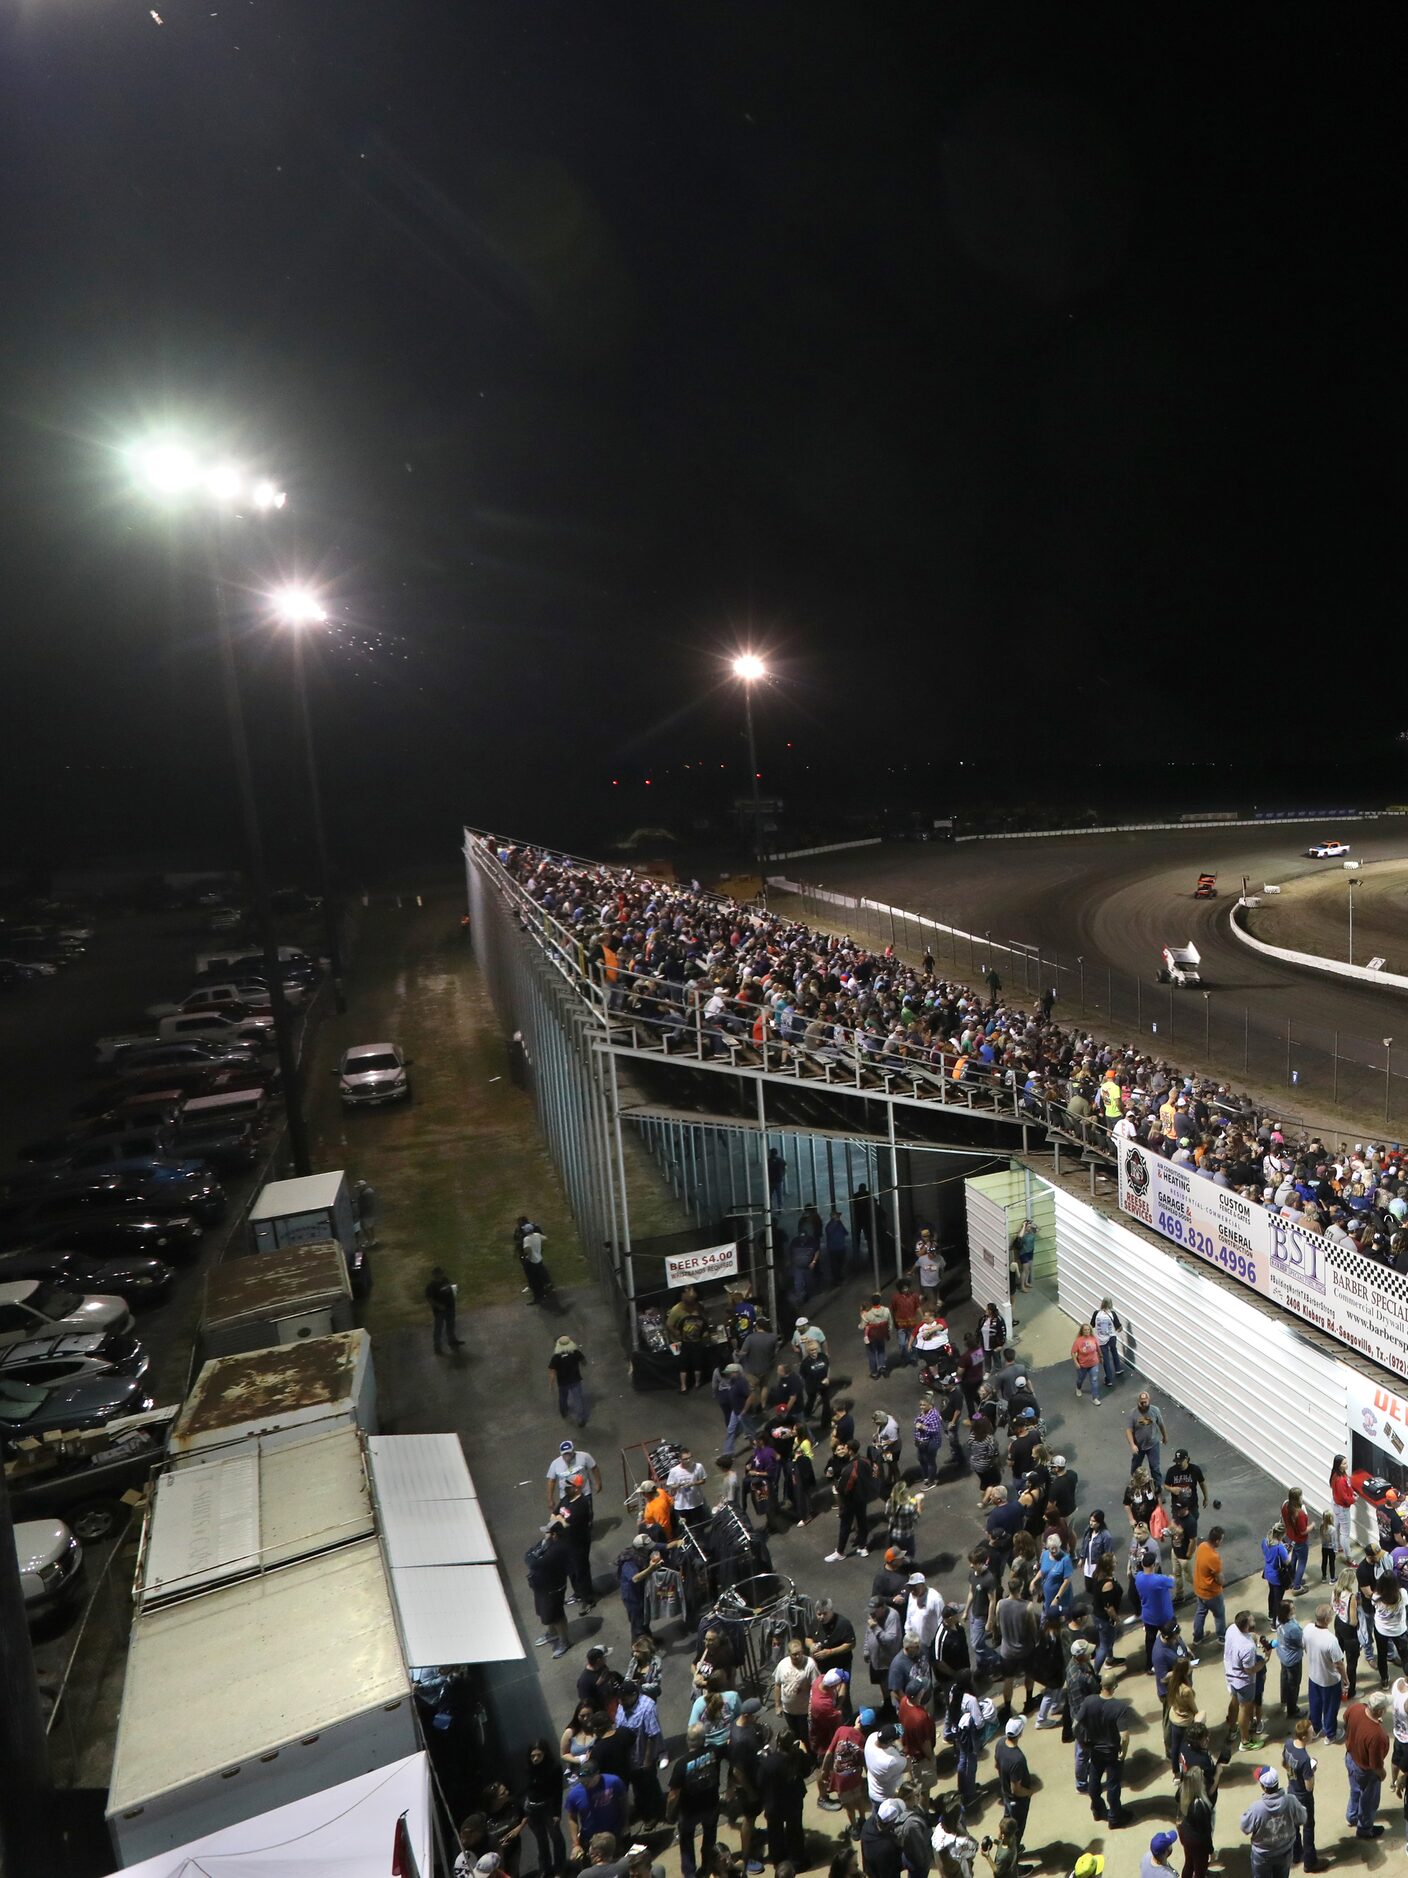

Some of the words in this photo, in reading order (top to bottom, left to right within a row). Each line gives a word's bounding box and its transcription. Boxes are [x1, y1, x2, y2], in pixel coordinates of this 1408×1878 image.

[1157, 1171, 1163, 1180] &
[1163, 1171, 1191, 1193] HEATING
[1163, 1165, 1191, 1183] CONDITIONING
[1124, 1201, 1153, 1225] SERVICES
[1157, 1191, 1185, 1214] GARAGE
[1186, 1206, 1192, 1217] &
[1219, 1193, 1251, 1218] CUSTOM
[1219, 1204, 1233, 1217] FENCE
[1236, 1213, 1251, 1225] GATES
[1158, 1211, 1257, 1284] 469.820.4996
[1218, 1224, 1253, 1251] GENERAL
[1218, 1235, 1253, 1259] CONSTRUCTION
[670, 1258, 699, 1271] BEER
[702, 1250, 733, 1266] $4.00
[1268, 1222, 1325, 1281] BSI
[707, 1260, 734, 1273] REQUIRED
[1332, 1270, 1369, 1301] BARBER
[1286, 1295, 1301, 1312] 2406
[1302, 1304, 1325, 1329] Kleberg
[1333, 1287, 1374, 1317] Commercial
[1376, 1310, 1405, 1331] Drywall
